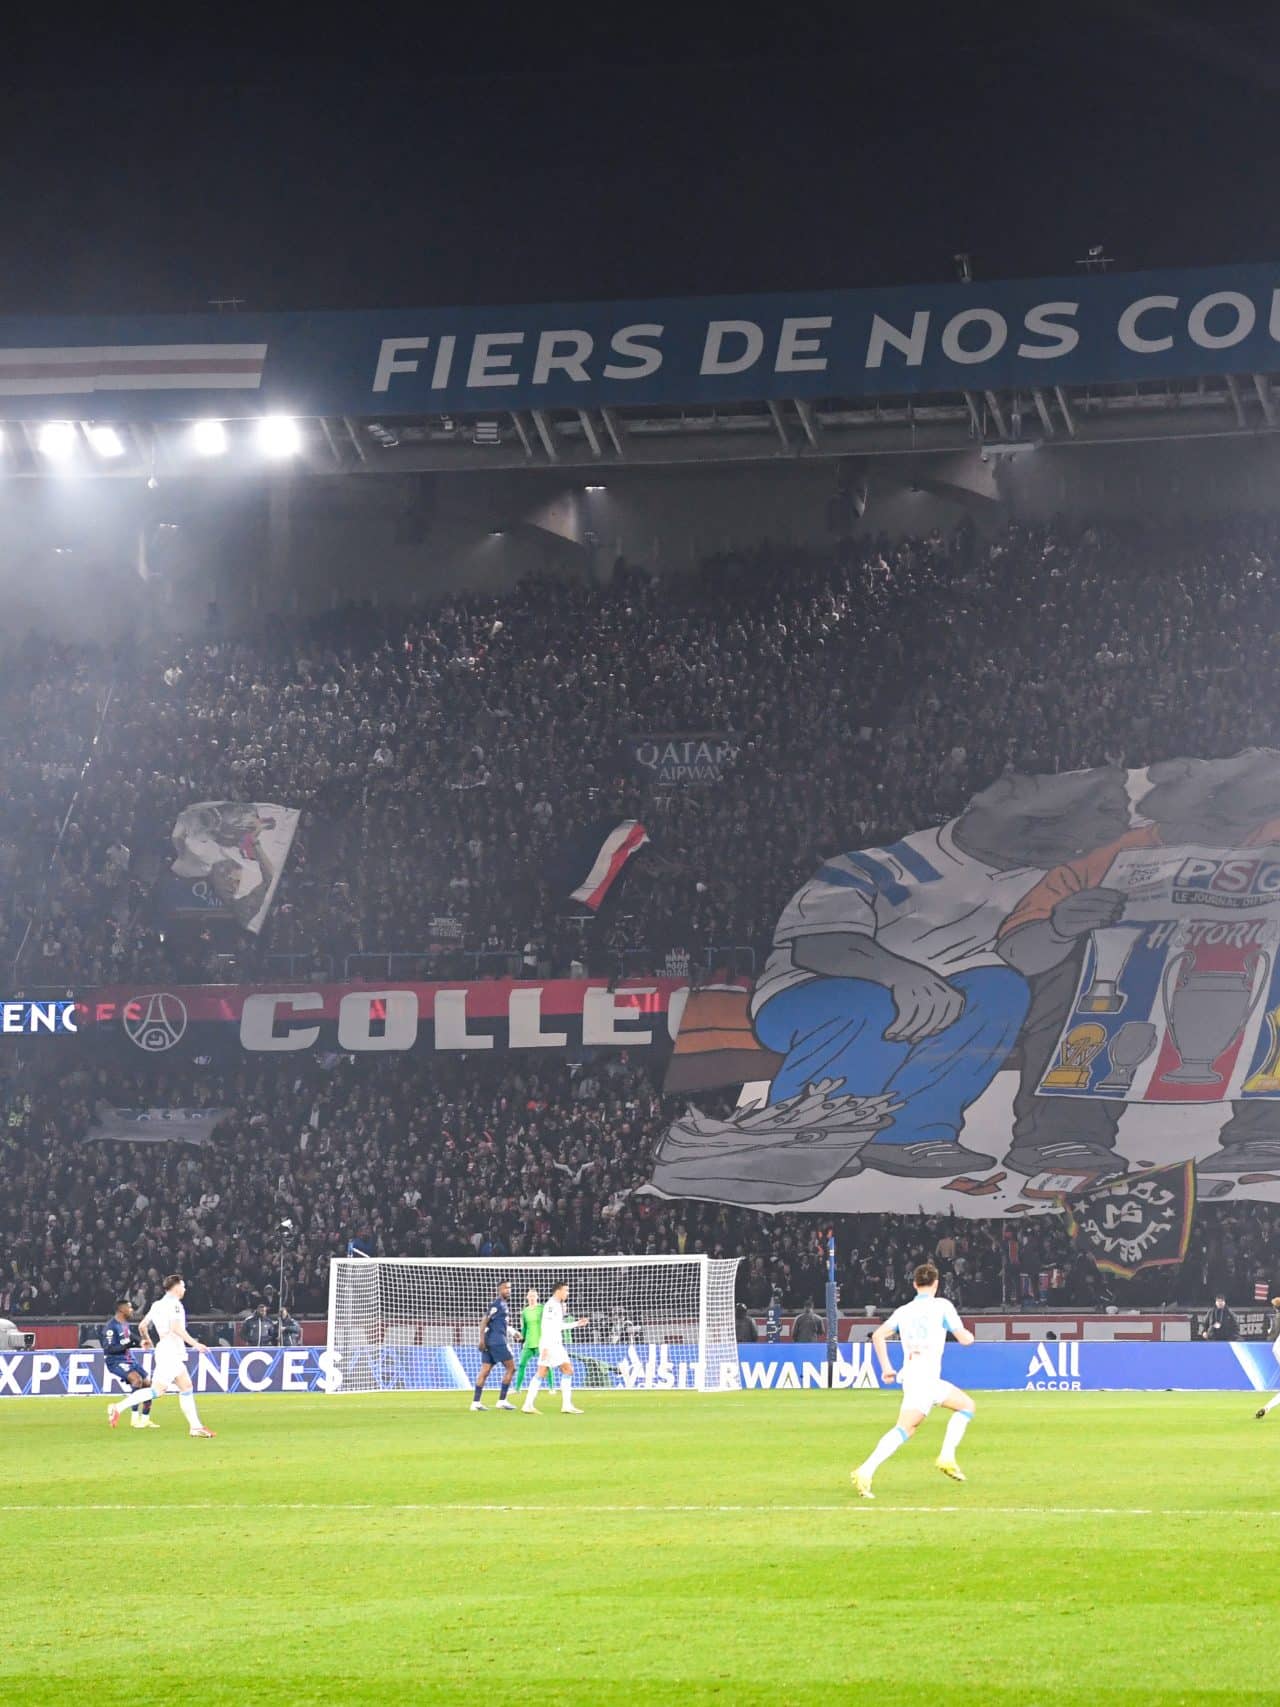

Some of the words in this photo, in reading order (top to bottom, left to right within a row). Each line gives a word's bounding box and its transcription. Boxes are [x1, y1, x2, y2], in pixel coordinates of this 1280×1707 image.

[372, 323, 664, 392] FIERS
[700, 316, 832, 376] DE
[865, 302, 1080, 368] NOS
[240, 986, 690, 1051] COLLE
[720, 1361, 880, 1389] RWANDA
[1026, 1342, 1081, 1377] All
[1025, 1381, 1082, 1391] ACCOR
